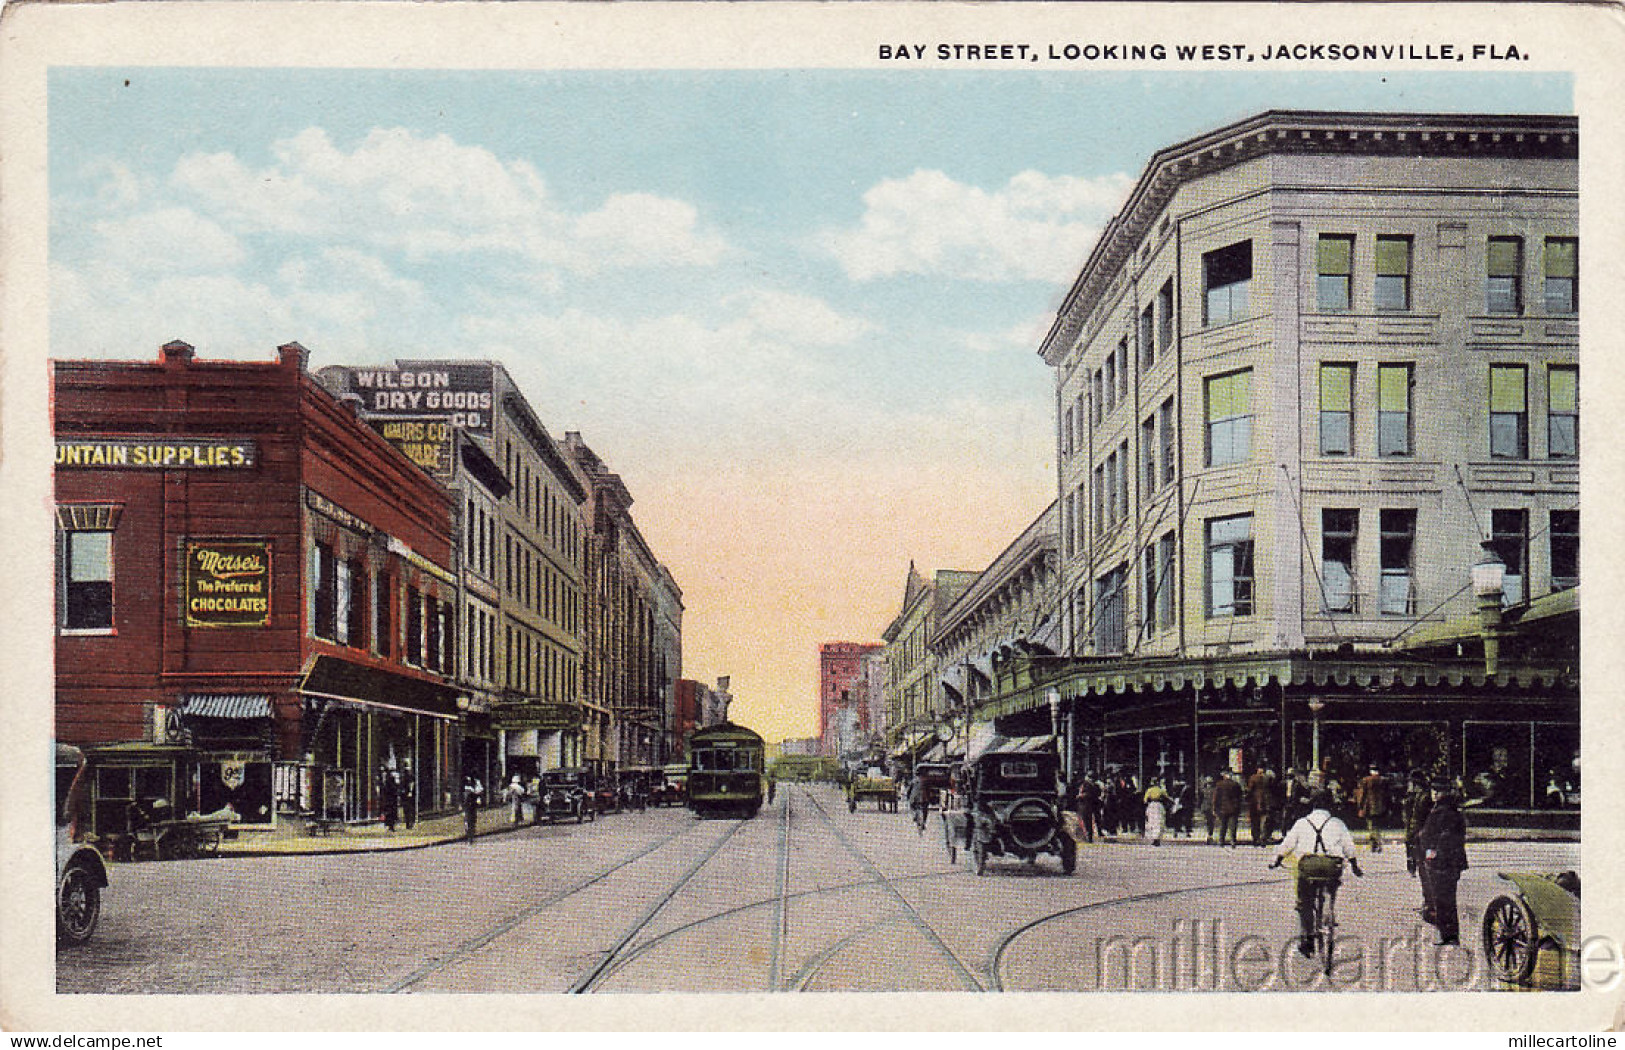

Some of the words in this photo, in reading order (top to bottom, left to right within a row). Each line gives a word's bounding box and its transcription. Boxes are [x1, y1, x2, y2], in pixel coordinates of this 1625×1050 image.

[880, 45, 926, 59] BAY
[938, 44, 1037, 62] STREET,
[1050, 44, 1166, 60] LOOKING
[1176, 44, 1255, 62] WEST,
[1262, 44, 1463, 62] JACKSONVILLE,
[1473, 45, 1529, 60] FLA.
[358, 371, 450, 388] WILSON
[375, 391, 422, 410] DRY
[426, 391, 491, 410] GOODS
[453, 411, 488, 428] CO.
[54, 444, 128, 465] UNTAIN
[133, 444, 254, 466] SUPPLIES.
[197, 579, 214, 593] The
[214, 579, 262, 593] Preferred
[190, 597, 268, 612] CHOCOLATES
